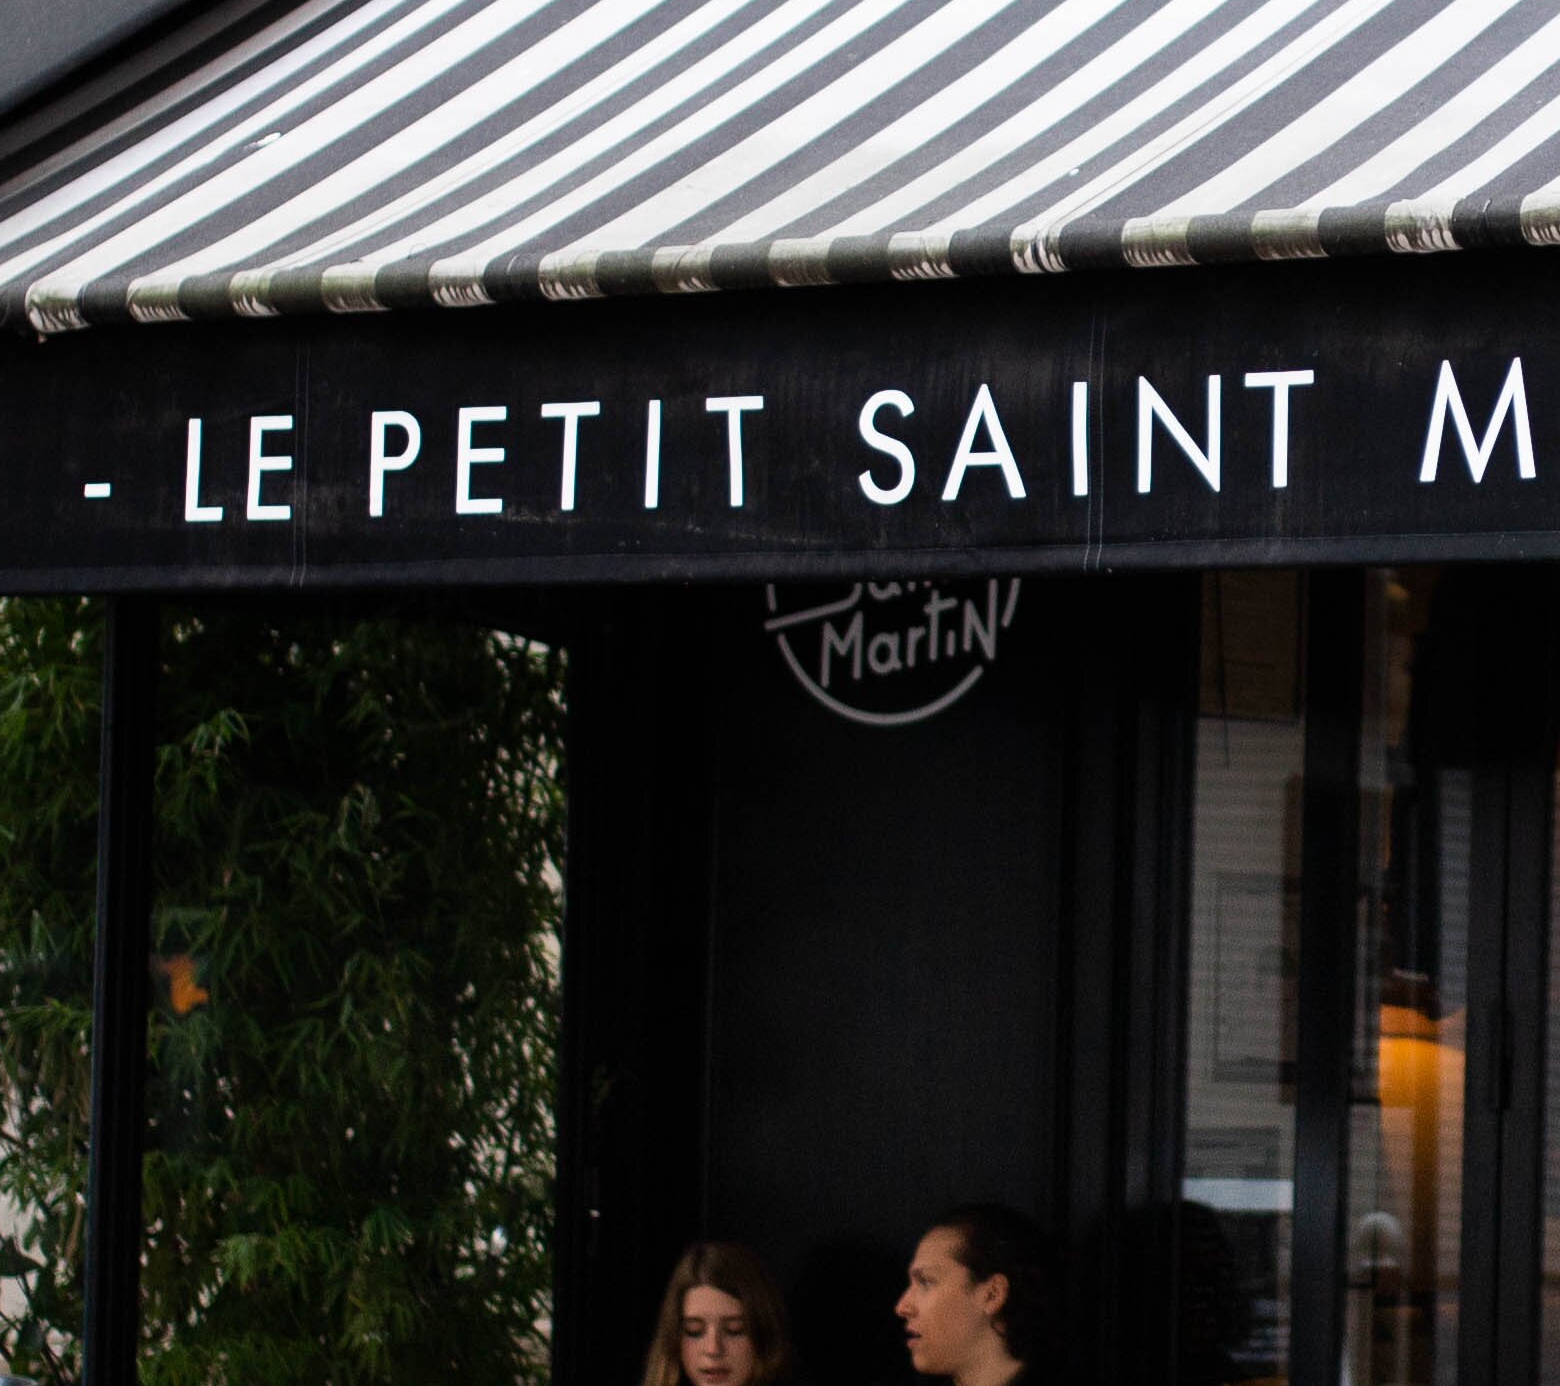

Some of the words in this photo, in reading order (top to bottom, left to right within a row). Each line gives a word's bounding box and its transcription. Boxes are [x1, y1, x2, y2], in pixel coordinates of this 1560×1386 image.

[184, 414, 294, 522] LE
[368, 395, 765, 519] PETIT
[856, 368, 1316, 506] SAINT
